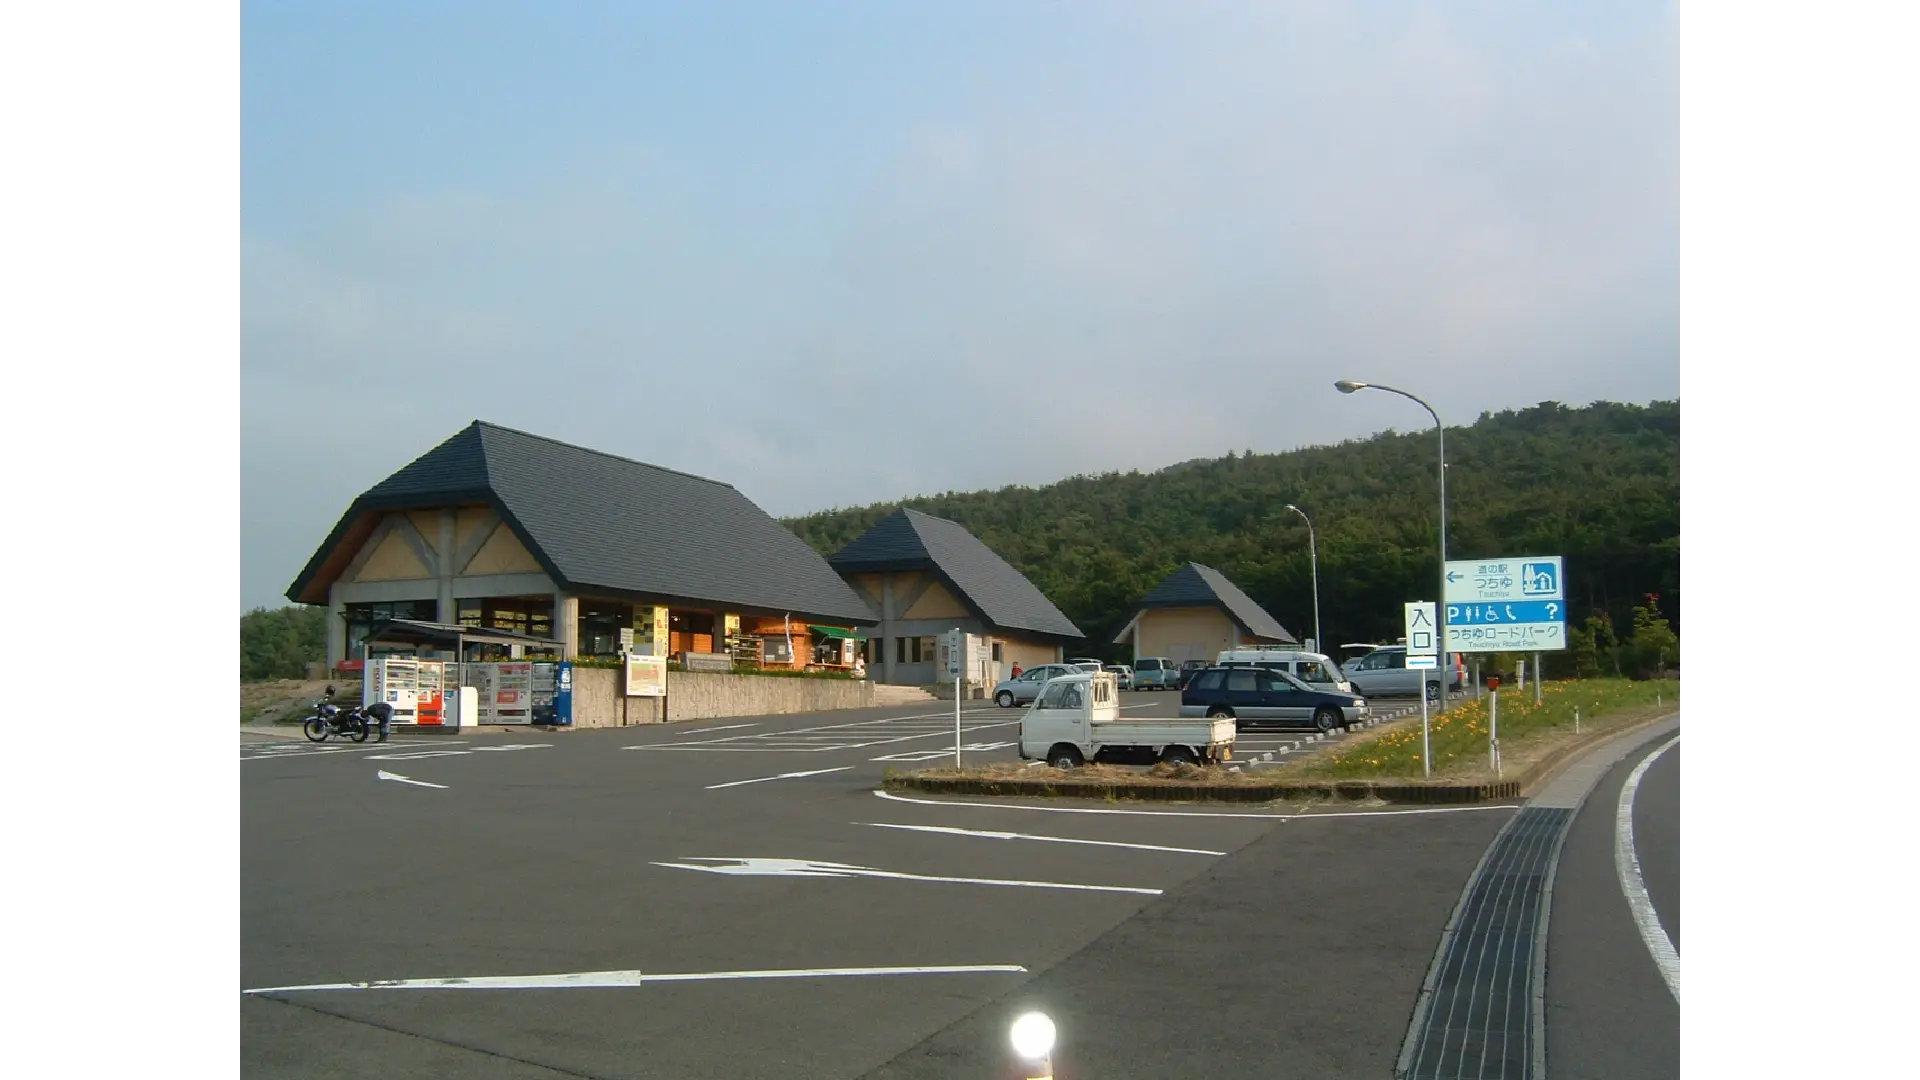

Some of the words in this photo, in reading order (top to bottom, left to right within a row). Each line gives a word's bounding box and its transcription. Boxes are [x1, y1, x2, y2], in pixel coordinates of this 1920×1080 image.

[1477, 563, 1508, 575] 道の駅
[1474, 576, 1513, 589] つちゆ
[1447, 606, 1459, 624] P
[1411, 608, 1432, 649] 入口
